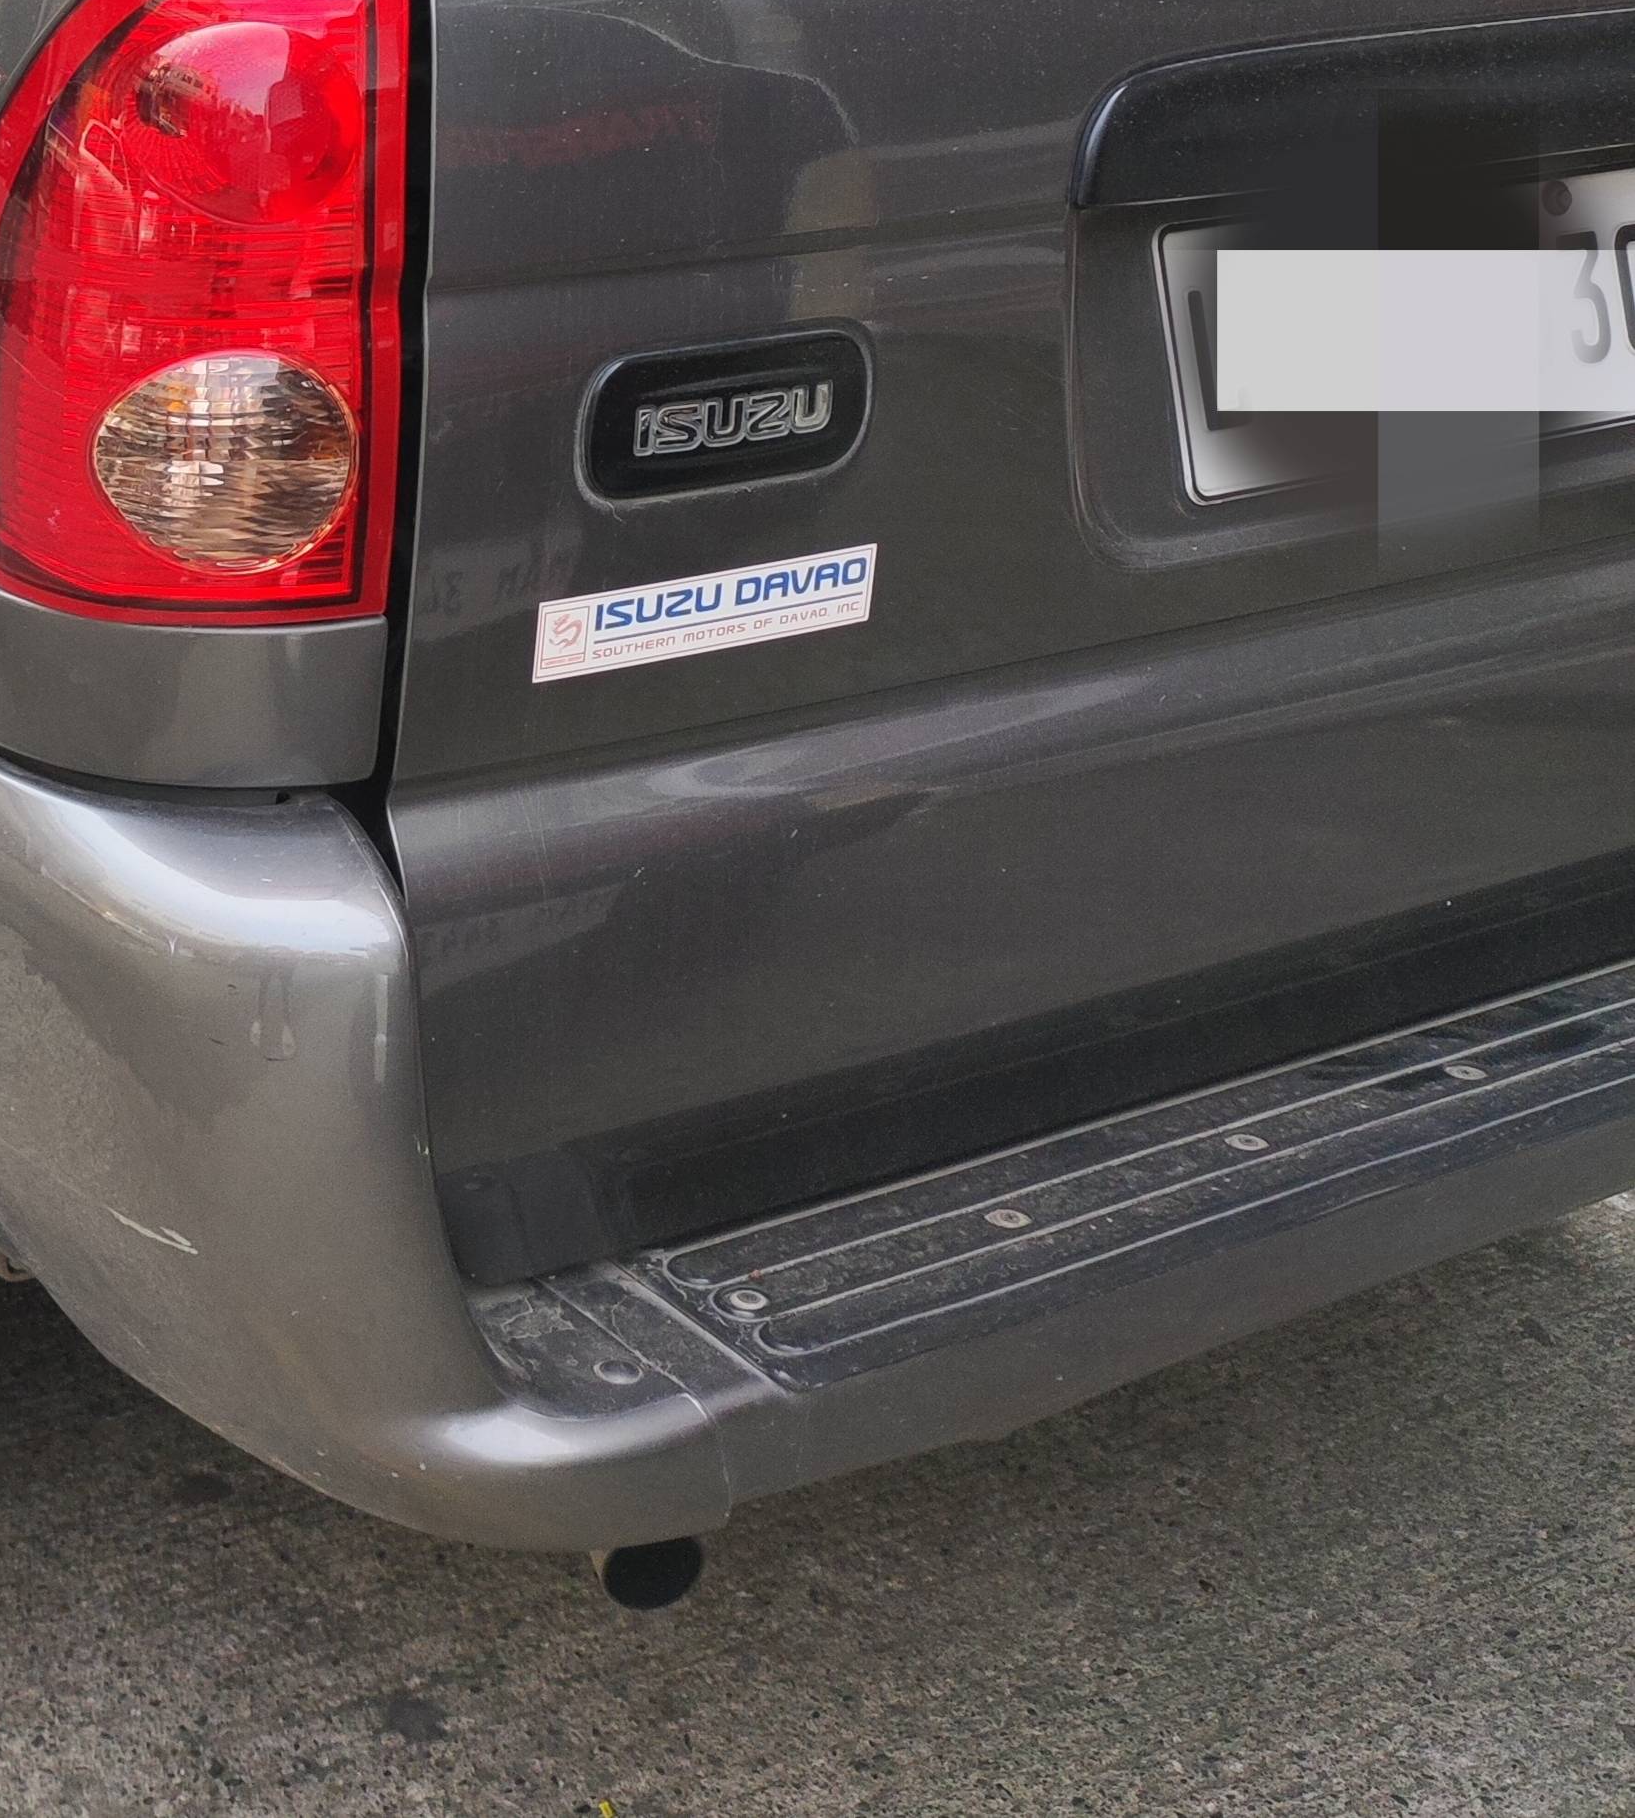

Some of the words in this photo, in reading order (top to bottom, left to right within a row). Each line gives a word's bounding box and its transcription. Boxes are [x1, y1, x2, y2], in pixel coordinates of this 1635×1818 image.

[631, 379, 834, 457] ISUZU
[594, 583, 723, 632] ISUZU
[734, 557, 867, 607] DAVAO
[592, 636, 676, 660] SOUTHERN
[682, 622, 747, 644] MOTORS
[753, 617, 773, 631] OF
